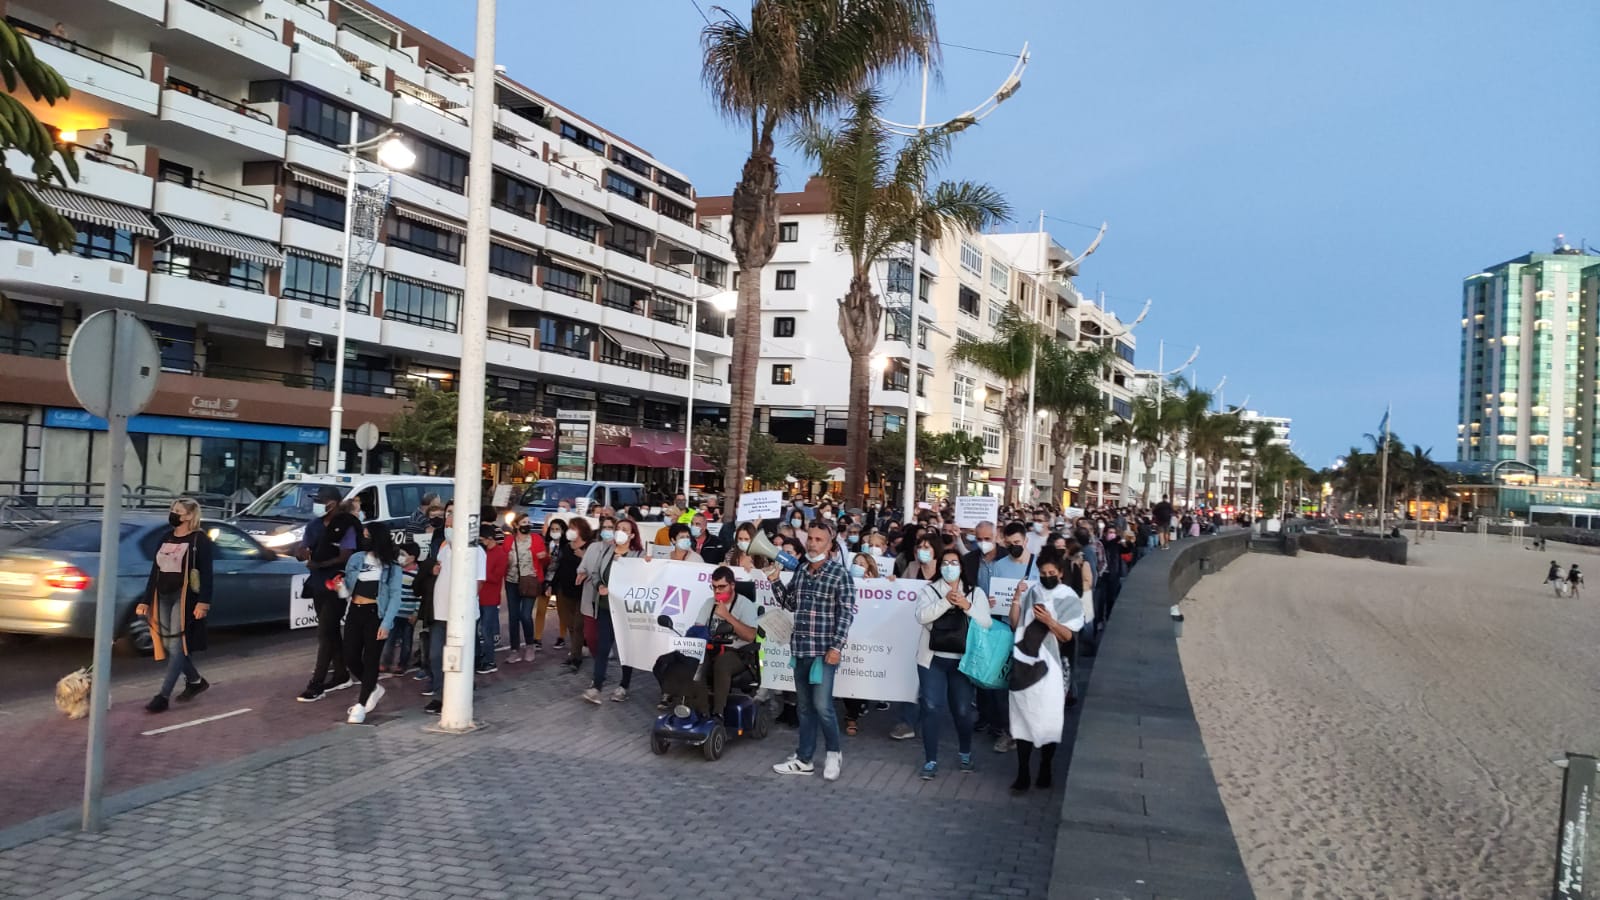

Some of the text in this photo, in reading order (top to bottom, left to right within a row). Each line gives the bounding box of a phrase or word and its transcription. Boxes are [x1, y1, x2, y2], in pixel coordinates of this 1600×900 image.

[192, 396, 221, 409] Canal
[754, 578, 770, 590] 969
[624, 587, 660, 600] ADIS
[897, 590, 917, 602] CO
[624, 600, 656, 613] LAN
[851, 643, 884, 654] apoyos
[886, 645, 893, 655] y
[764, 647, 781, 656] ndo
[840, 654, 851, 663] da
[852, 656, 865, 664] de
[772, 674, 794, 682] y sus
[841, 668, 887, 678] intelectual
